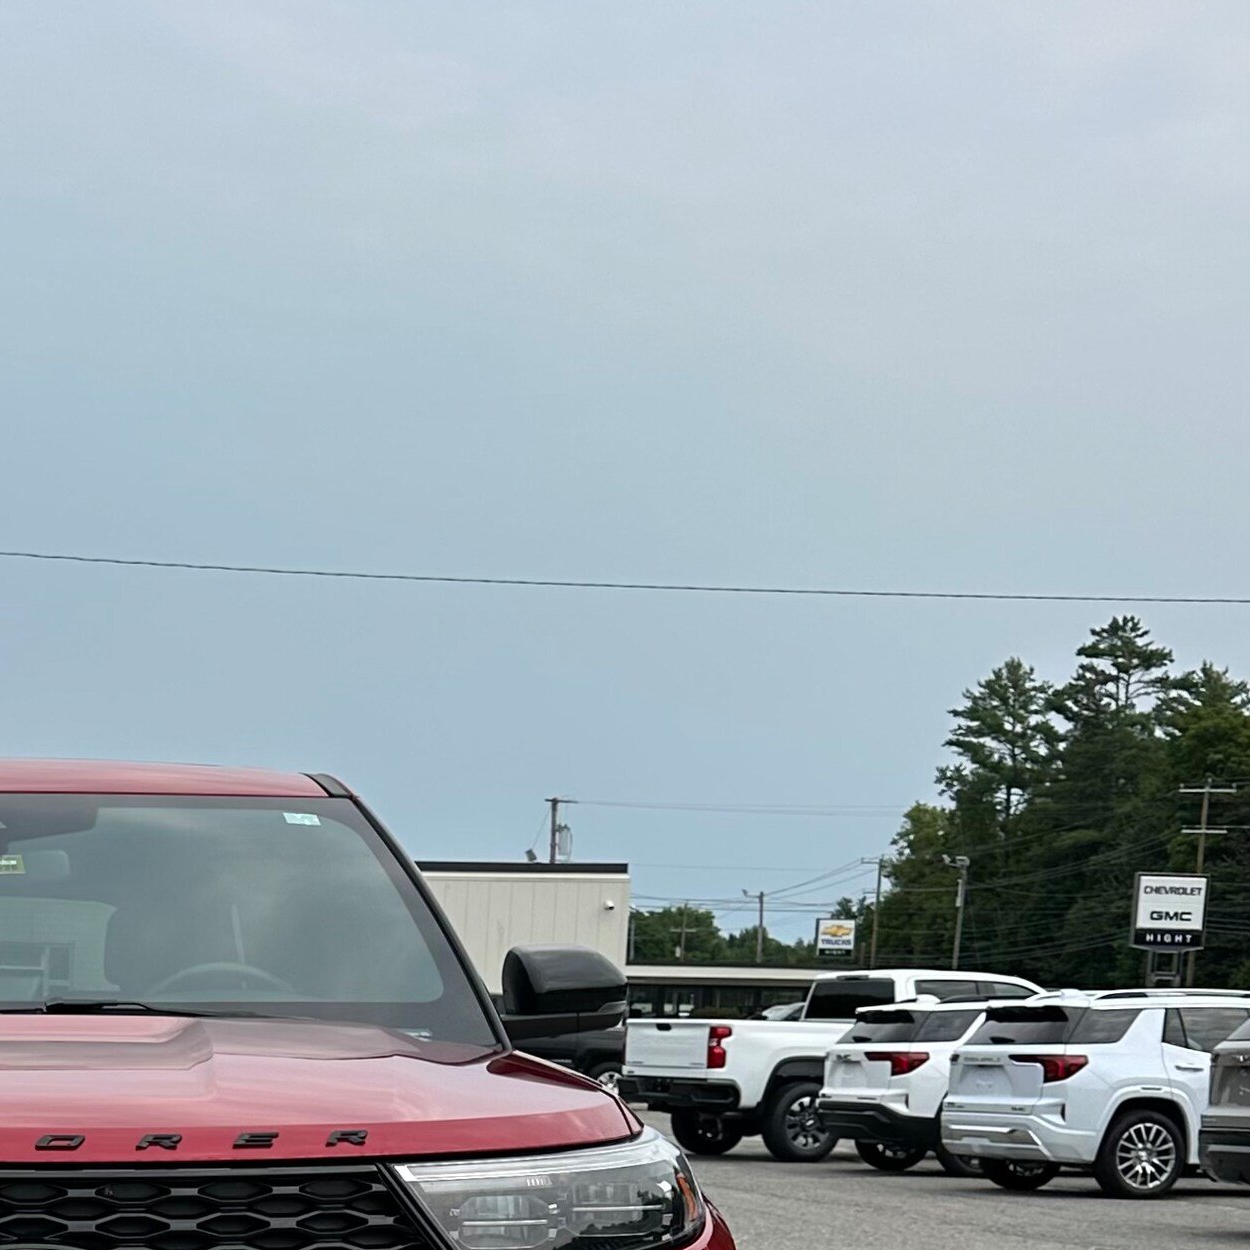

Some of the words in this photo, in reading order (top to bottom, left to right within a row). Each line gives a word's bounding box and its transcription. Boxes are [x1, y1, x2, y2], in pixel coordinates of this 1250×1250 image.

[1144, 885, 1202, 896] CHEVROLET
[1150, 911, 1192, 921] GMC
[1146, 933, 1192, 943] HIGHT
